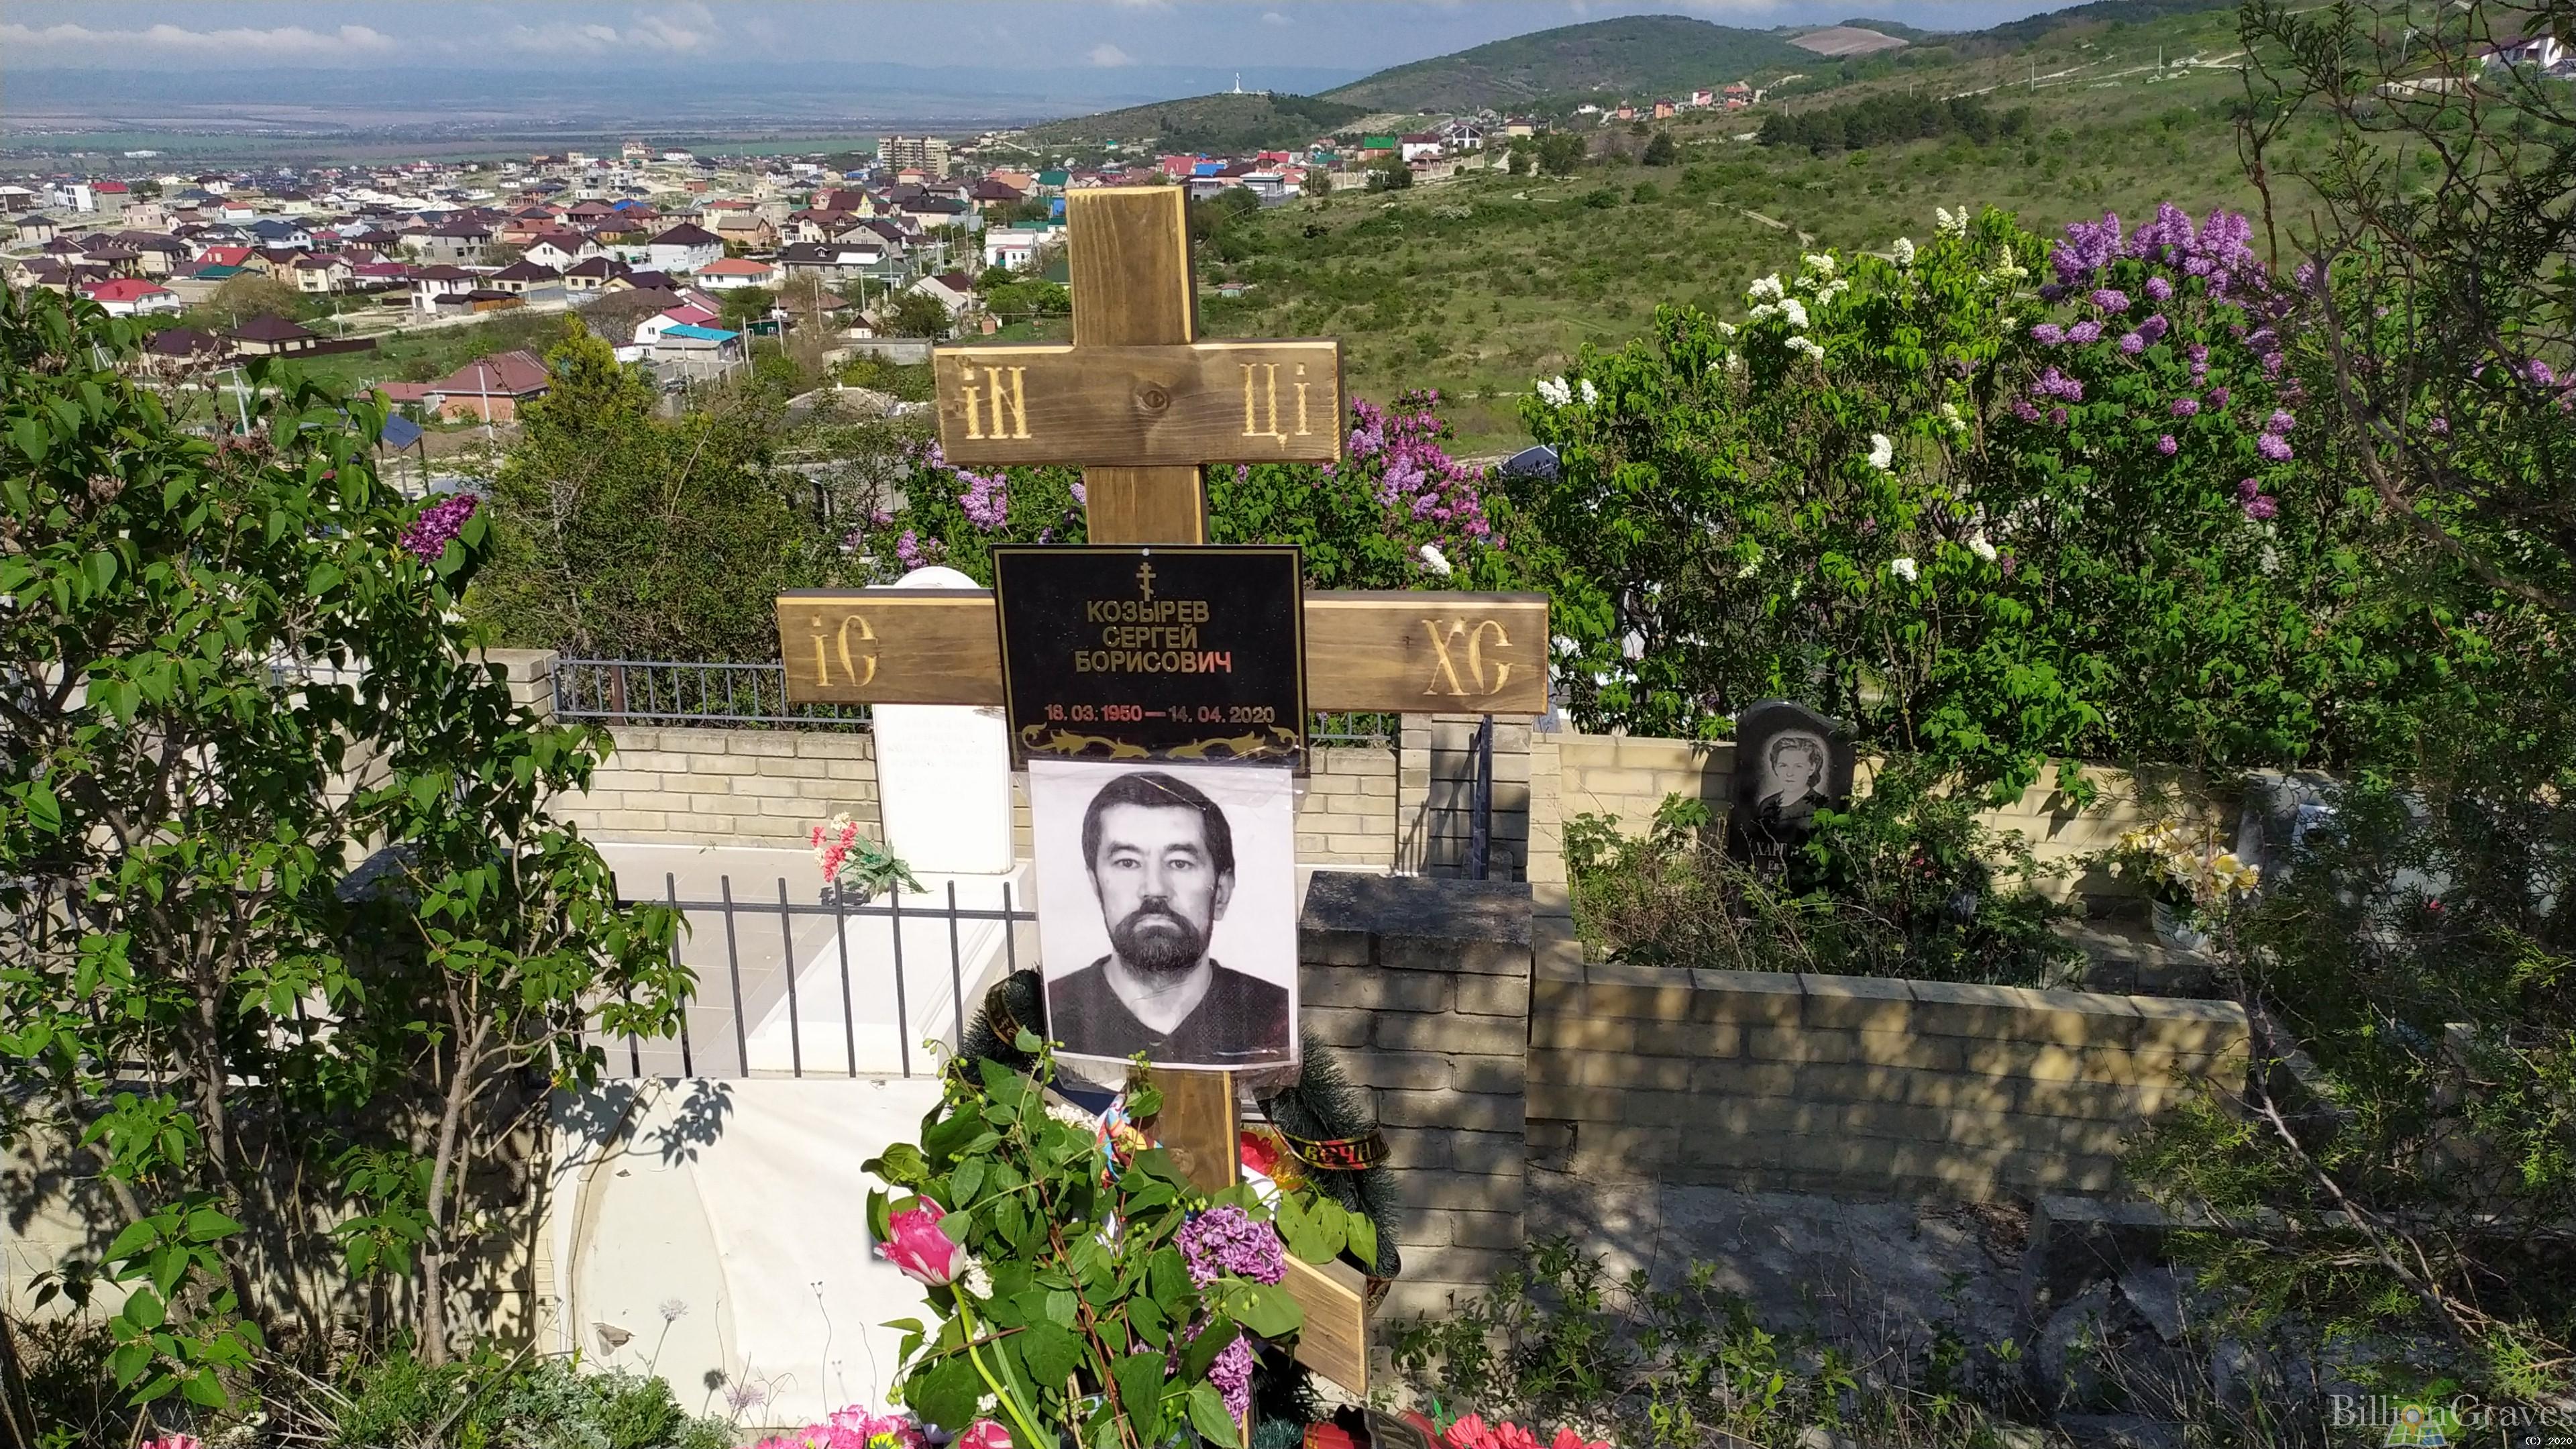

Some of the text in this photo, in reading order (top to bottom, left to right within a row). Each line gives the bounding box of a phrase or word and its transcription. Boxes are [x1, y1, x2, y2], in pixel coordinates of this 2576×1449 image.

[1086, 600, 1210, 623] КОЗЫРЕВ
[1102, 624, 1199, 649] СЕРГЕЙ
[1075, 650, 1232, 674] БОРИСОВИЧ
